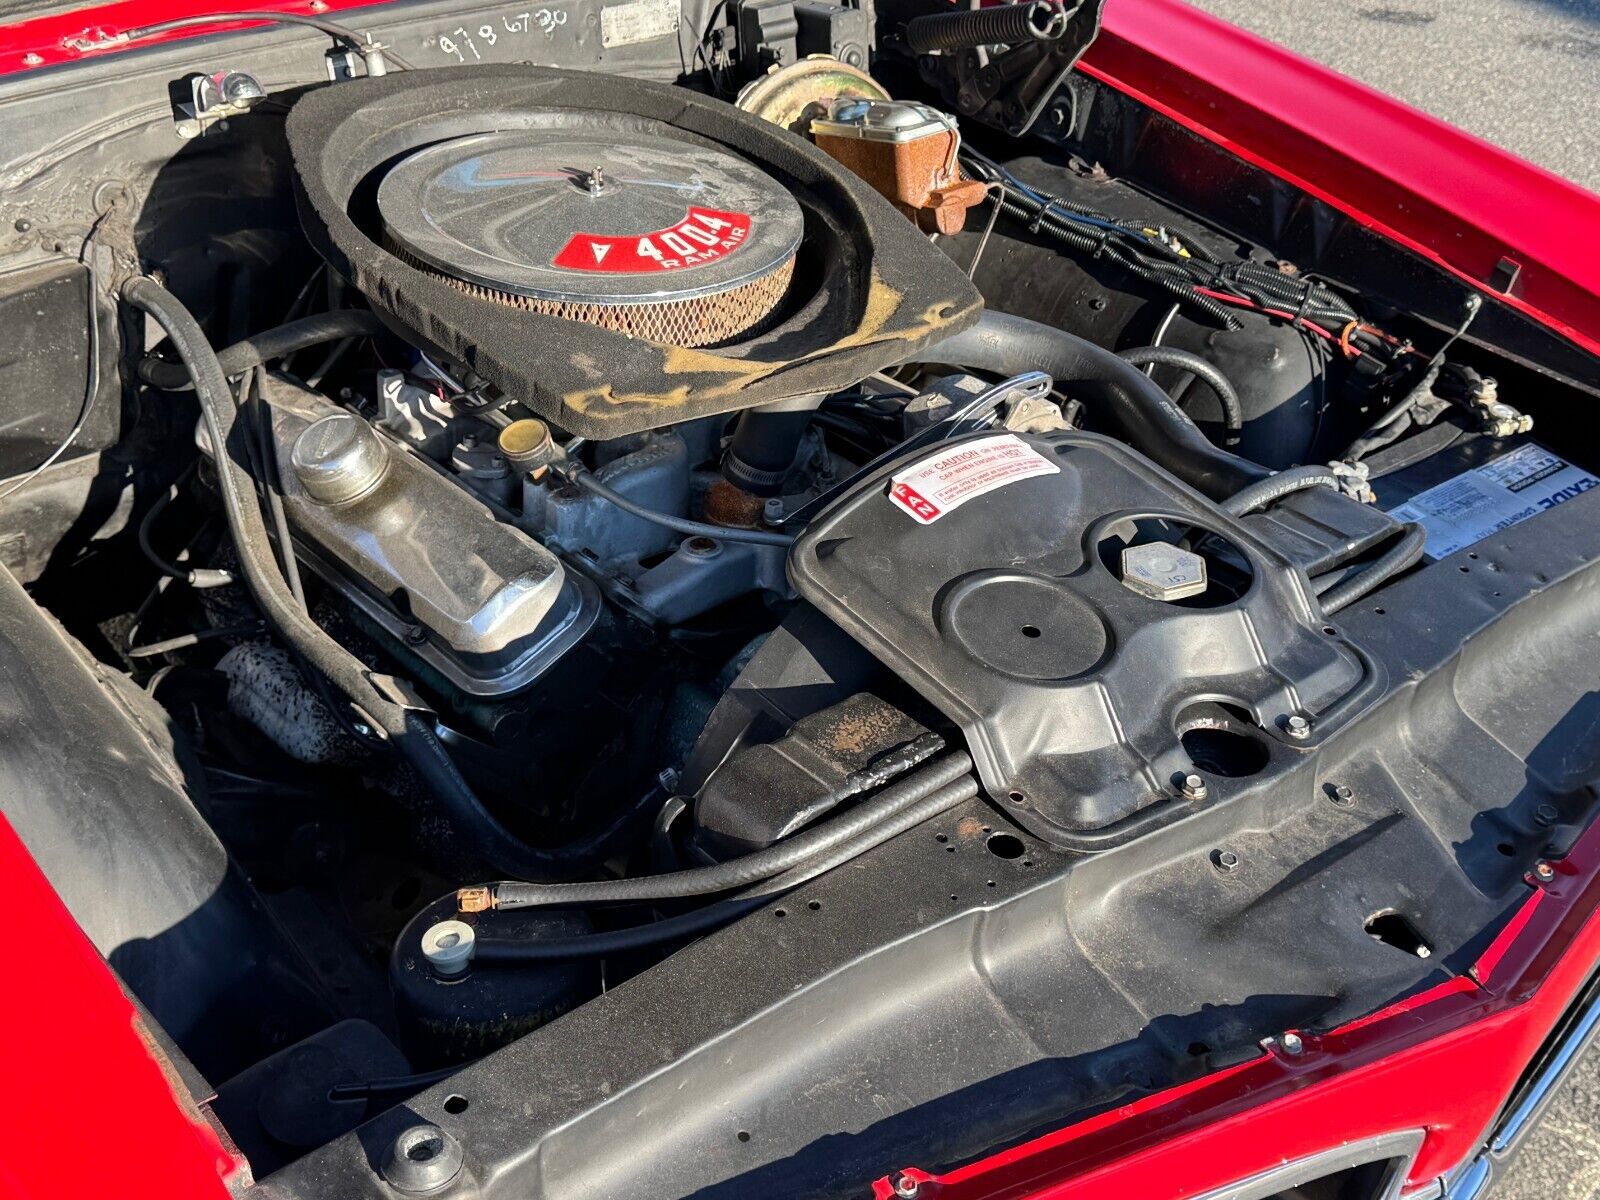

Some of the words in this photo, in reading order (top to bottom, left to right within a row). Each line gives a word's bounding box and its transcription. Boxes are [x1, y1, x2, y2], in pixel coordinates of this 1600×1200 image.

[661, 248, 720, 269] RAM
[721, 227, 746, 250] AIR
[919, 469, 934, 479] USE
[934, 449, 980, 470] CAUTION
[939, 471, 953, 481] CAP
[954, 463, 974, 474] WHEN
[974, 455, 997, 466] ENGINE
[895, 485, 935, 516] FAN
[1537, 478, 1600, 509] EXIDE
